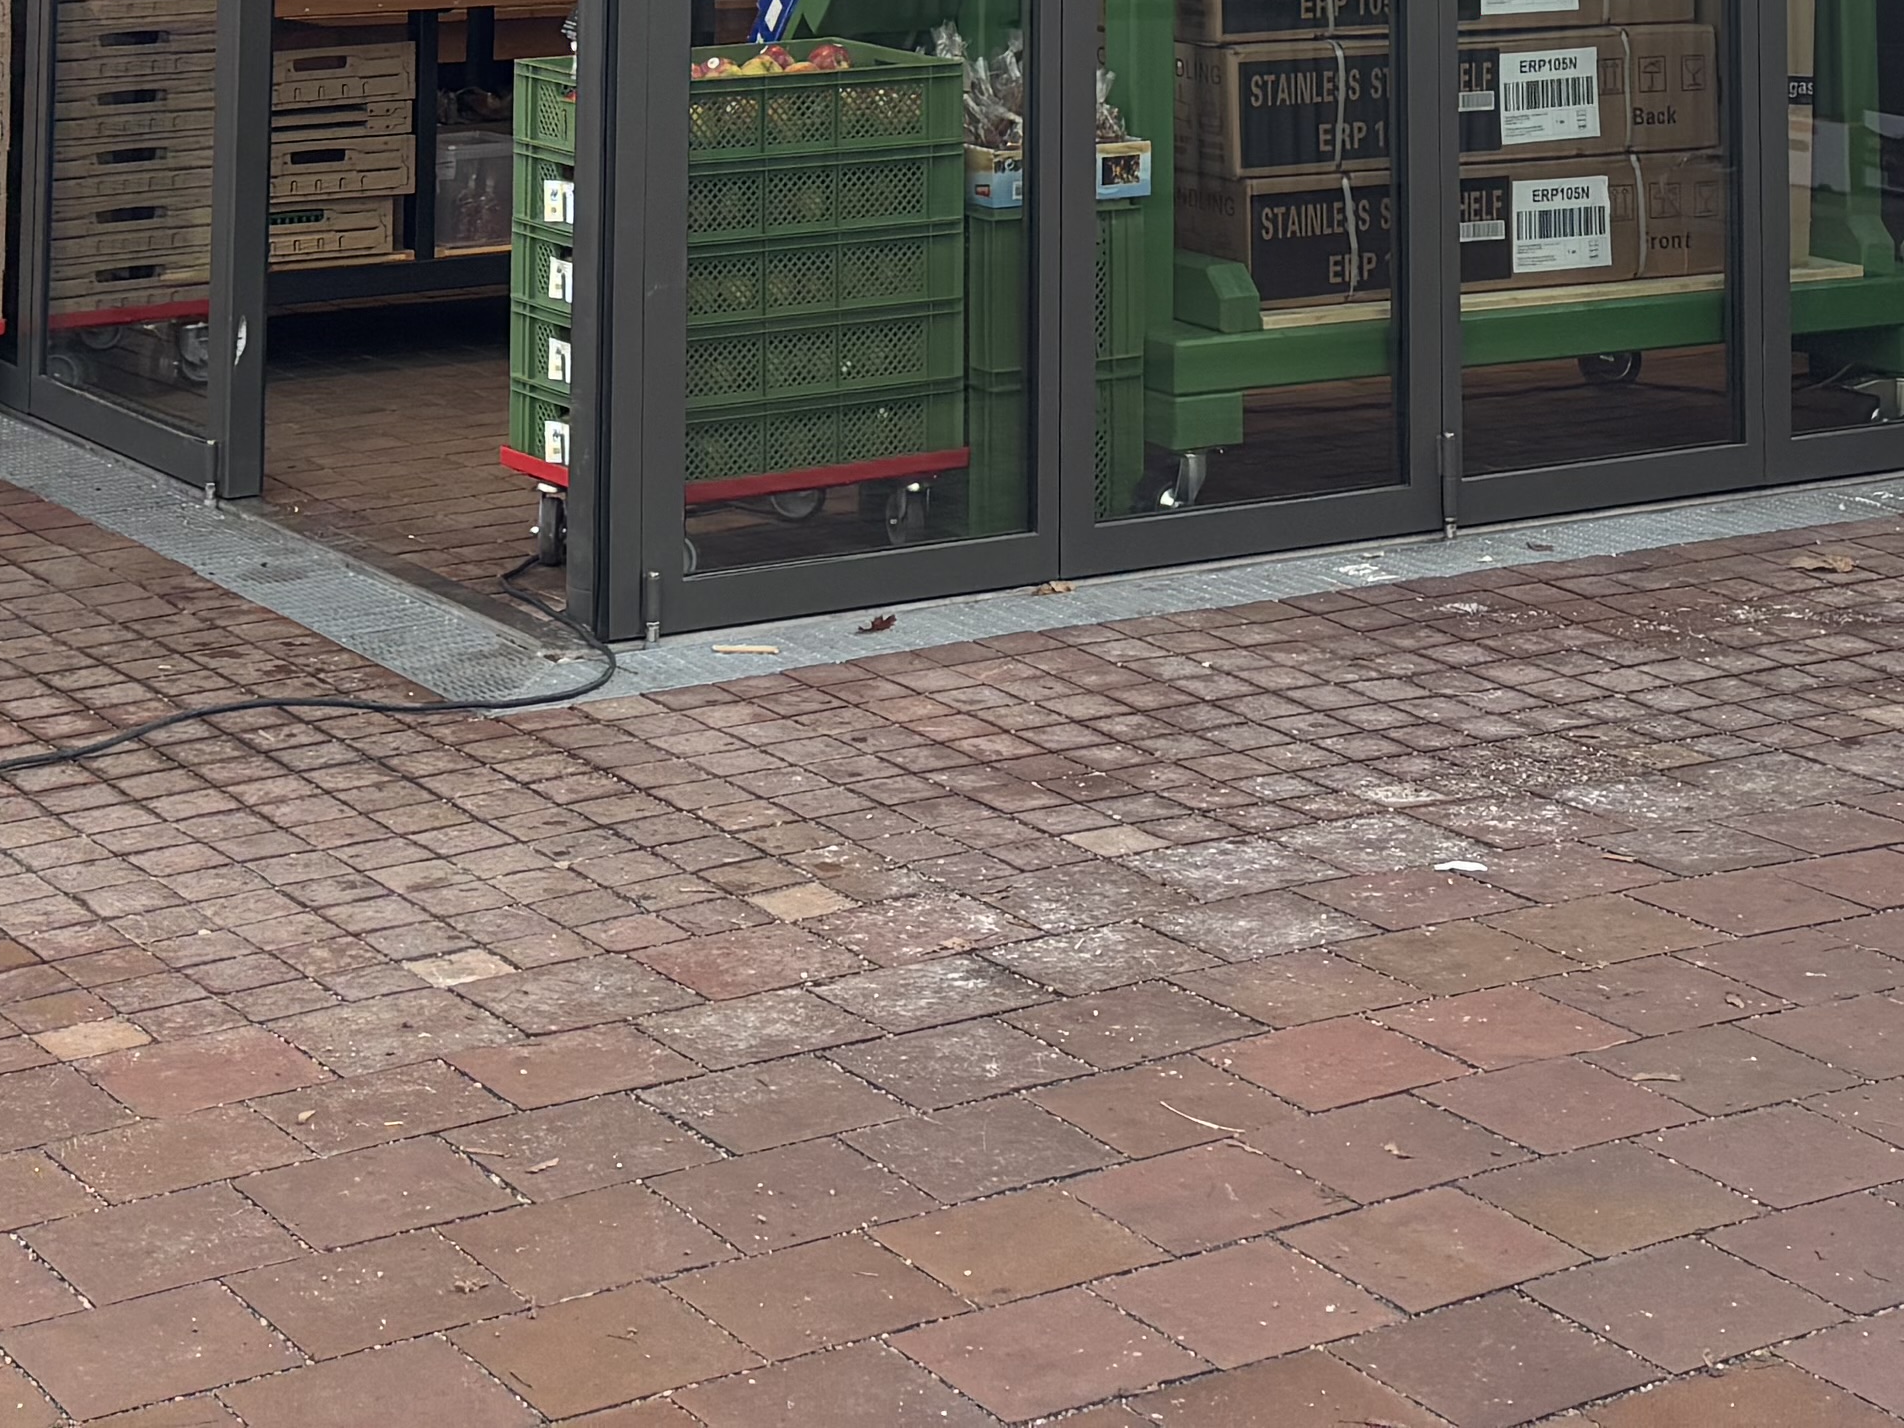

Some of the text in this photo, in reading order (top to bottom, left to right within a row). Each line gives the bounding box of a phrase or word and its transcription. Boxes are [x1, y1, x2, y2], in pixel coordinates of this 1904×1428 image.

[1519, 56, 1578, 74] ERP105N
[1632, 106, 1677, 126] Back
[1532, 186, 1590, 203] ERP105N
